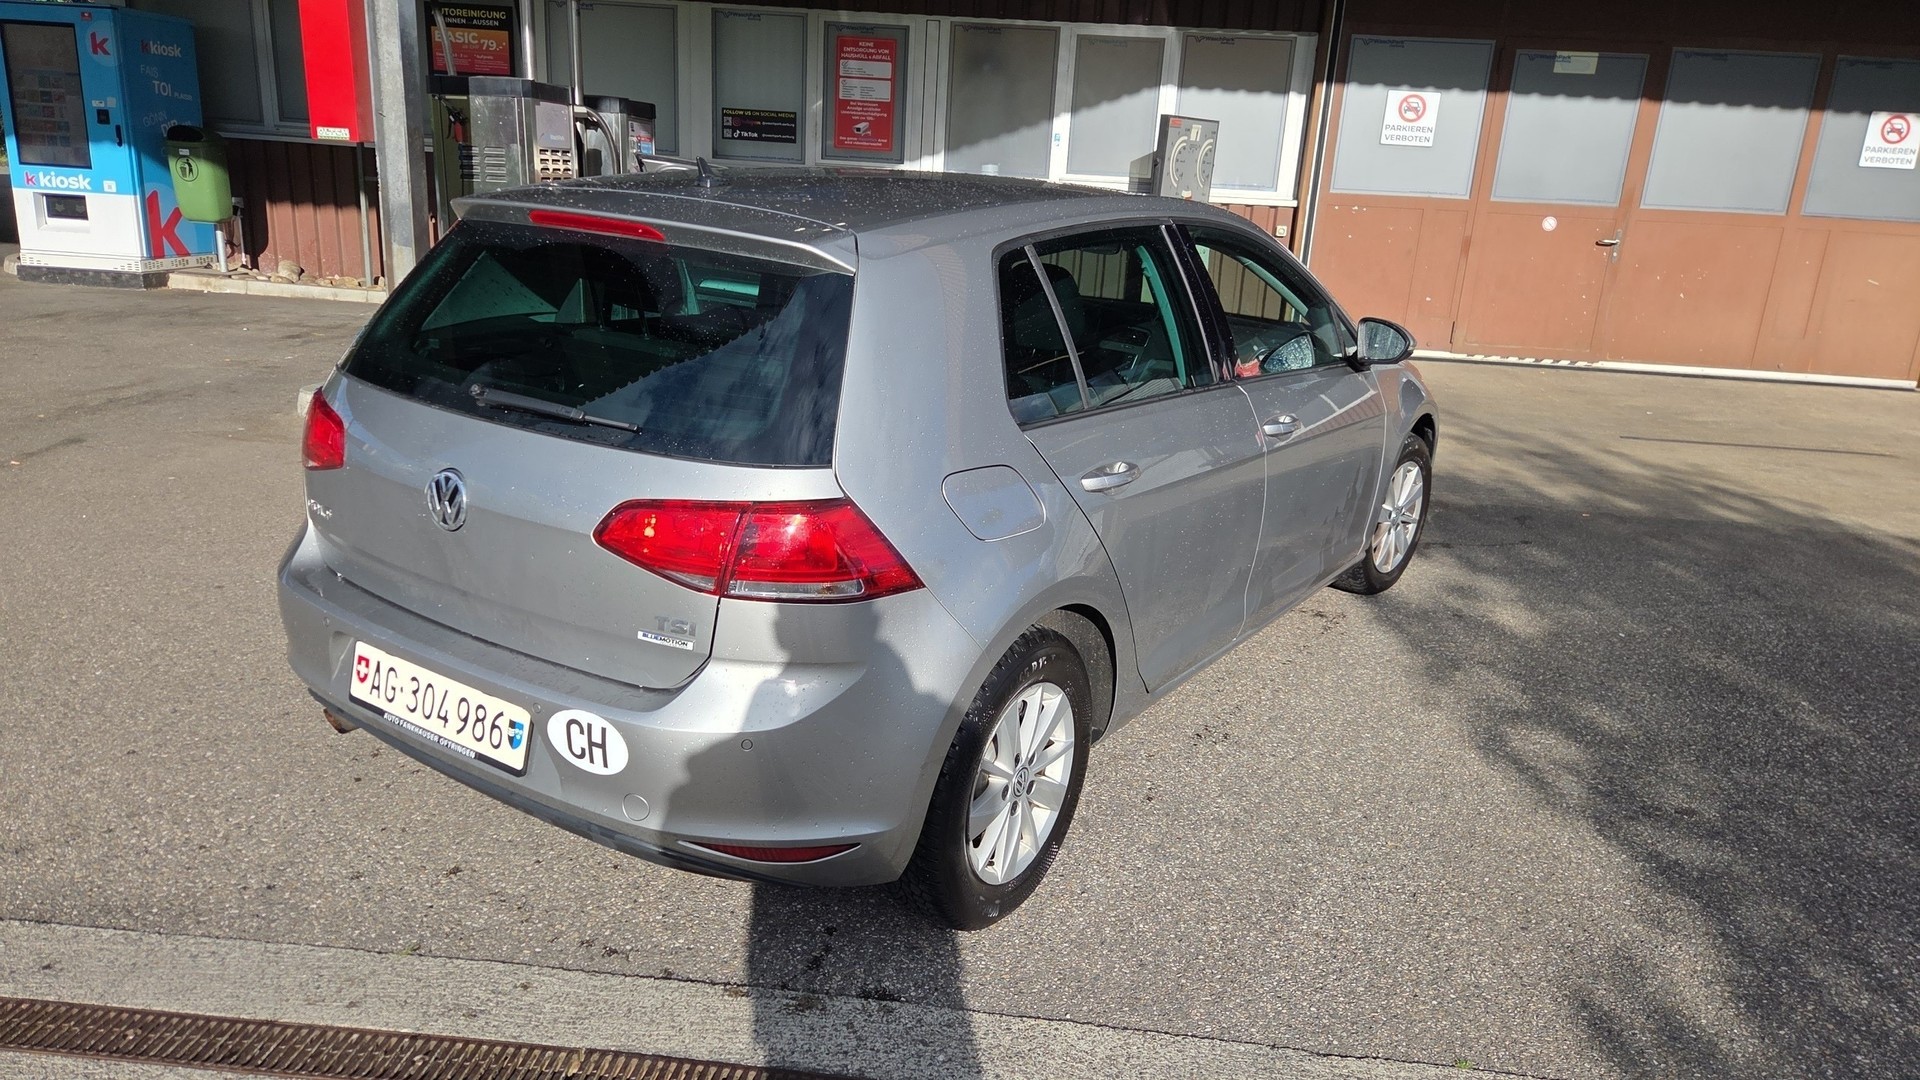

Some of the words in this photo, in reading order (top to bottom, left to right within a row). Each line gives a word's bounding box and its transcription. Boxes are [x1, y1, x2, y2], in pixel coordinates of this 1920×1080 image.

[431, 7, 506, 19] UTOREINIGUNG
[445, 17, 466, 25] INNEN
[472, 18, 499, 26] AUSSEN
[90, 32, 111, 56] k
[150, 40, 182, 58] kiosk
[152, 80, 172, 97] TOI
[1385, 124, 1433, 134] PARKIEREN
[1384, 134, 1431, 143] VERBOTEN
[1865, 146, 1917, 156] PARKIEREN
[1864, 156, 1913, 165] VERBOTEN
[24, 171, 37, 187] k
[38, 171, 92, 190] kiosk
[146, 189, 192, 259] k
[655, 615, 697, 637] TSI
[642, 632, 688, 647] BLUEMOTION
[383, 712, 399, 725] AUTO
[399, 719, 439, 743] FANKHAUSER
[439, 737, 476, 759] OFTRINGEN
[565, 718, 609, 769] CH
